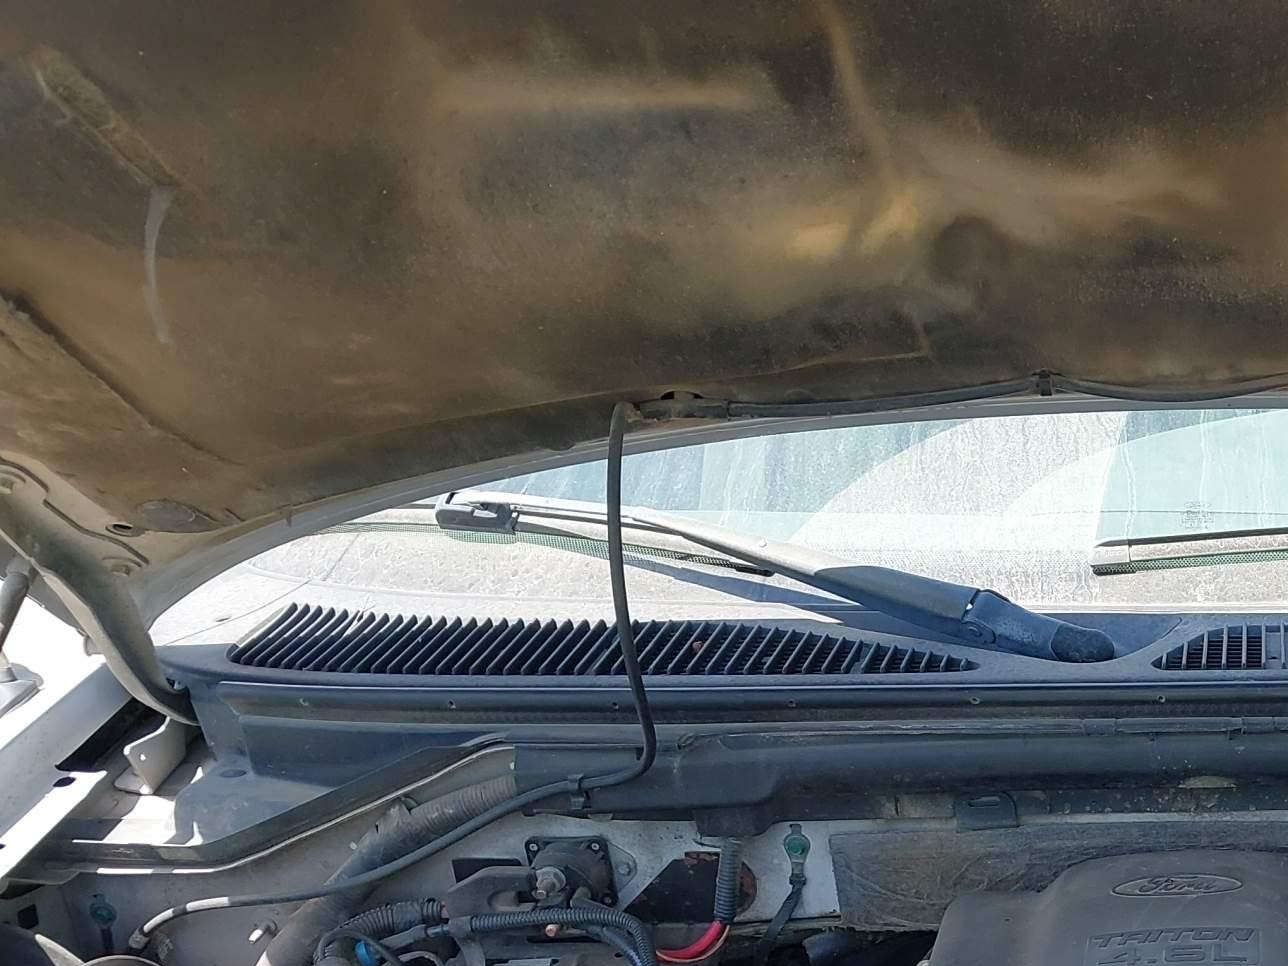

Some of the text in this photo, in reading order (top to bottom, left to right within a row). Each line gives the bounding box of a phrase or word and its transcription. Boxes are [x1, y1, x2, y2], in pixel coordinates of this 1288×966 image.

[1138, 875, 1218, 894] Ford
[1092, 927, 1256, 948] TRITON
[1097, 943, 1248, 966] 4.6L
